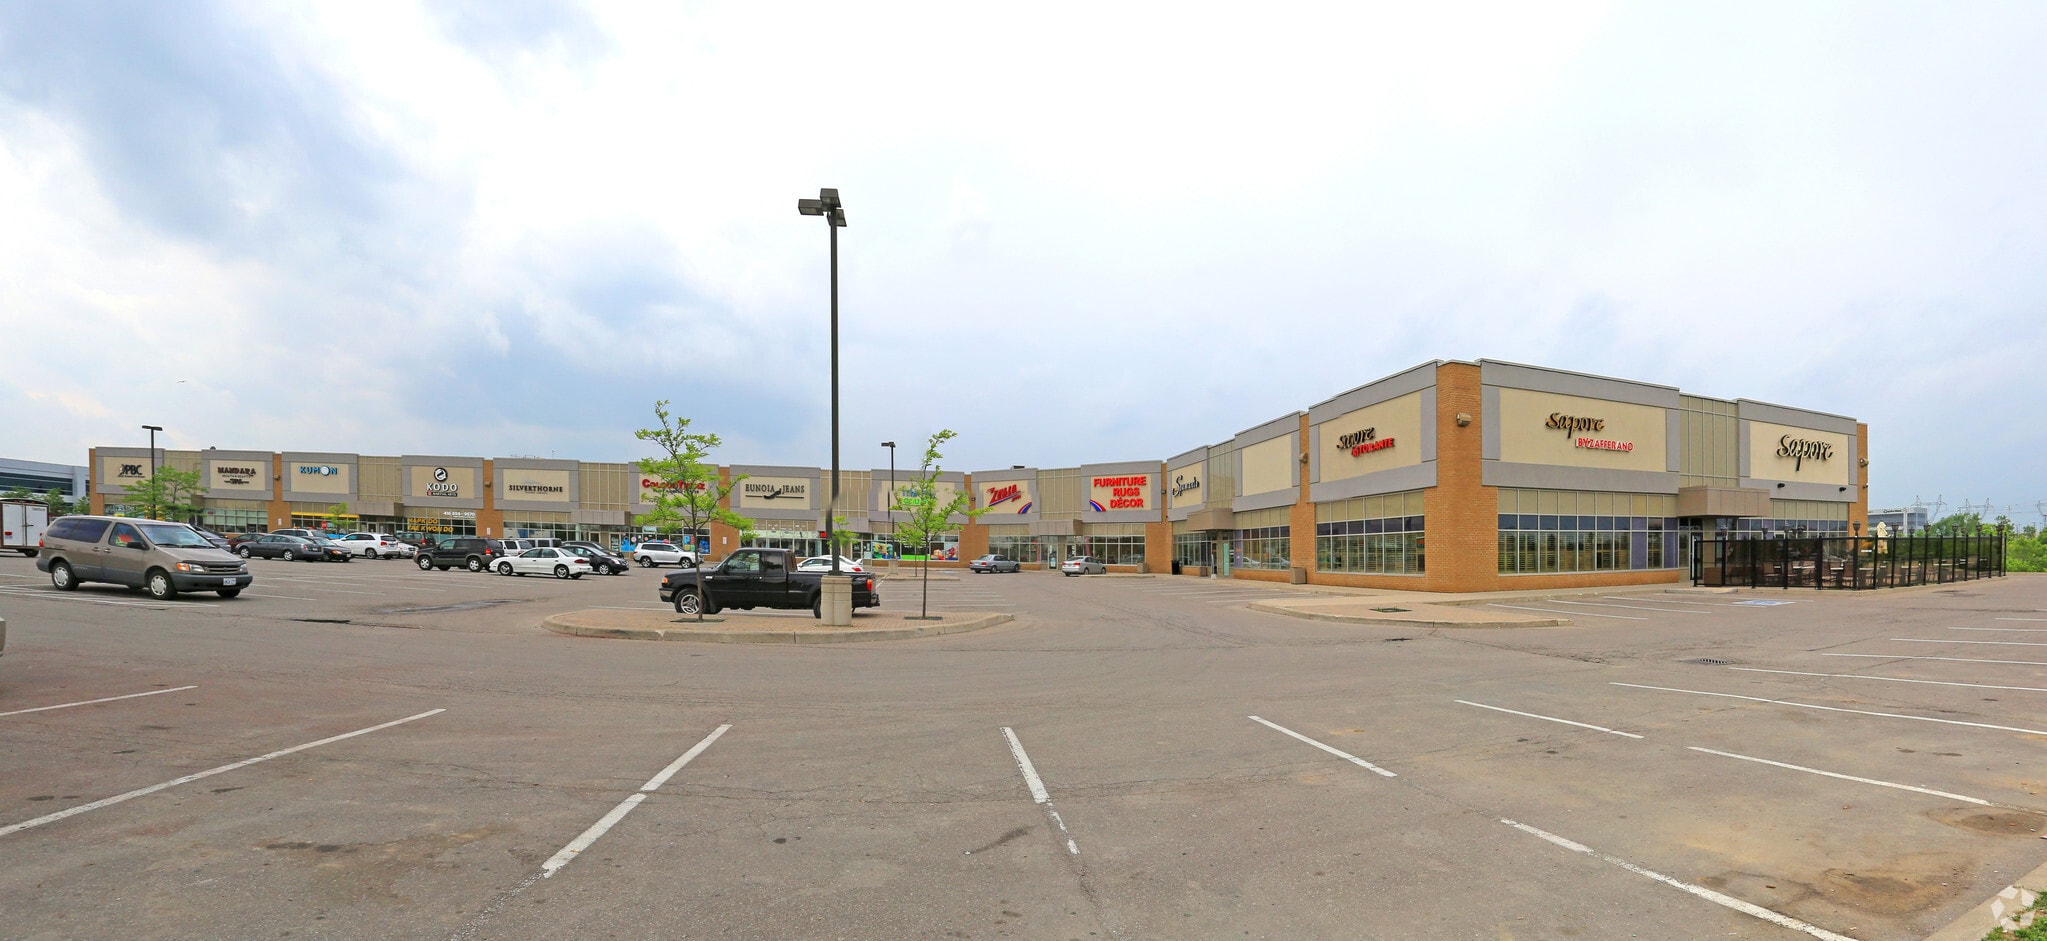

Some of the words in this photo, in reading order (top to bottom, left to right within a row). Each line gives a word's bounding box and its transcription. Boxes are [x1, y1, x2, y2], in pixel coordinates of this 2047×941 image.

[1589, 439, 1634, 451] ZAFFERANO
[1776, 434, 1833, 471] Sapore
[217, 466, 257, 475] MANDARA
[299, 465, 338, 476] KUMON
[426, 482, 459, 492] KODO
[1093, 476, 1147, 488] FURNITURE
[508, 484, 564, 493] SILVERTHORNE
[745, 484, 775, 492] EUNOIA
[781, 485, 805, 494] JEANS
[1113, 487, 1140, 497] RUGS
[1110, 497, 1144, 509] DÉCOR
